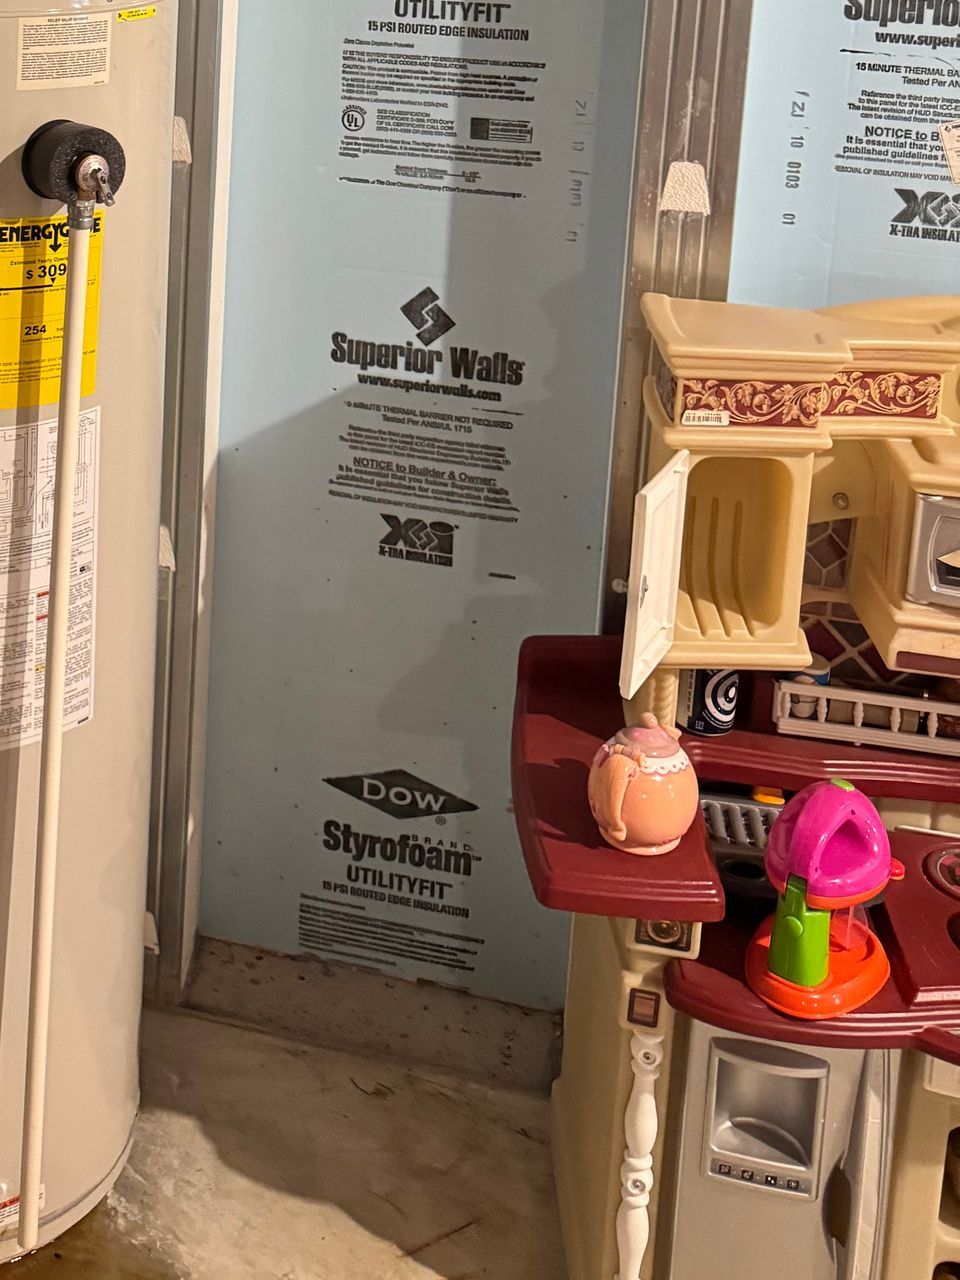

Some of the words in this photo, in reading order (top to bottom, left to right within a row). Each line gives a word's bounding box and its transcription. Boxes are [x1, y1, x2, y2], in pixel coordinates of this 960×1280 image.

[368, 20, 379, 32] 15
[379, 21, 396, 33] PSI
[397, 22, 437, 36] ROUTED
[439, 24, 466, 38] EDGE
[467, 26, 529, 41] INSULATION
[856, 62, 866, 71] 15
[868, 63, 902, 73] MINUTE
[903, 66, 945, 76] THERMAL
[902, 76, 930, 86] Tested
[932, 79, 946, 87] Per
[880, 99, 897, 107] panel
[924, 95, 940, 103] party
[881, 106, 906, 115] revision
[864, 125, 913, 139] NOTICE
[915, 130, 927, 140] to
[790, 135, 804, 148] 10
[846, 135, 854, 143] It
[855, 136, 863, 144] is
[865, 137, 907, 149] essential
[909, 142, 927, 150] that
[843, 145, 889, 157] published
[891, 150, 938, 161] guidelines
[785, 161, 802, 189] 0103
[873, 169, 909, 178] INSULATION
[782, 213, 795, 226] 01
[890, 224, 920, 238] X-TRA
[38, 264, 67, 278] 309
[24, 325, 47, 335] 254
[330, 331, 443, 375] Superior
[449, 346, 524, 386] Walls
[357, 373, 502, 402] www.superiorwalls.com
[383, 405, 418, 417] THERMAL
[419, 410, 454, 421] BARRIER
[455, 415, 471, 424] NOT
[472, 417, 513, 430] REQUIRED
[407, 418, 420, 427] Per
[454, 425, 473, 434] 1715
[353, 456, 393, 471] NOTICE
[396, 464, 406, 473] to
[408, 465, 445, 479] Builder
[447, 470, 457, 481] &
[458, 472, 497, 487] Owner:
[354, 467, 390, 479] essential
[391, 471, 406, 481] that
[408, 474, 423, 484] you
[425, 475, 449, 487] follow
[450, 479, 485, 493] Superior
[376, 479, 416, 492] guidelines
[418, 484, 429, 493] for
[431, 486, 482, 501] construction
[361, 777, 446, 812] DOW
[322, 820, 472, 876] Styrofoam
[346, 865, 448, 900] UTILITYFIT
[333, 882, 348, 895] PSI
[350, 886, 386, 902] ROUTED
[387, 893, 412, 908] EDGE
[413, 898, 470, 918] INSULATION
